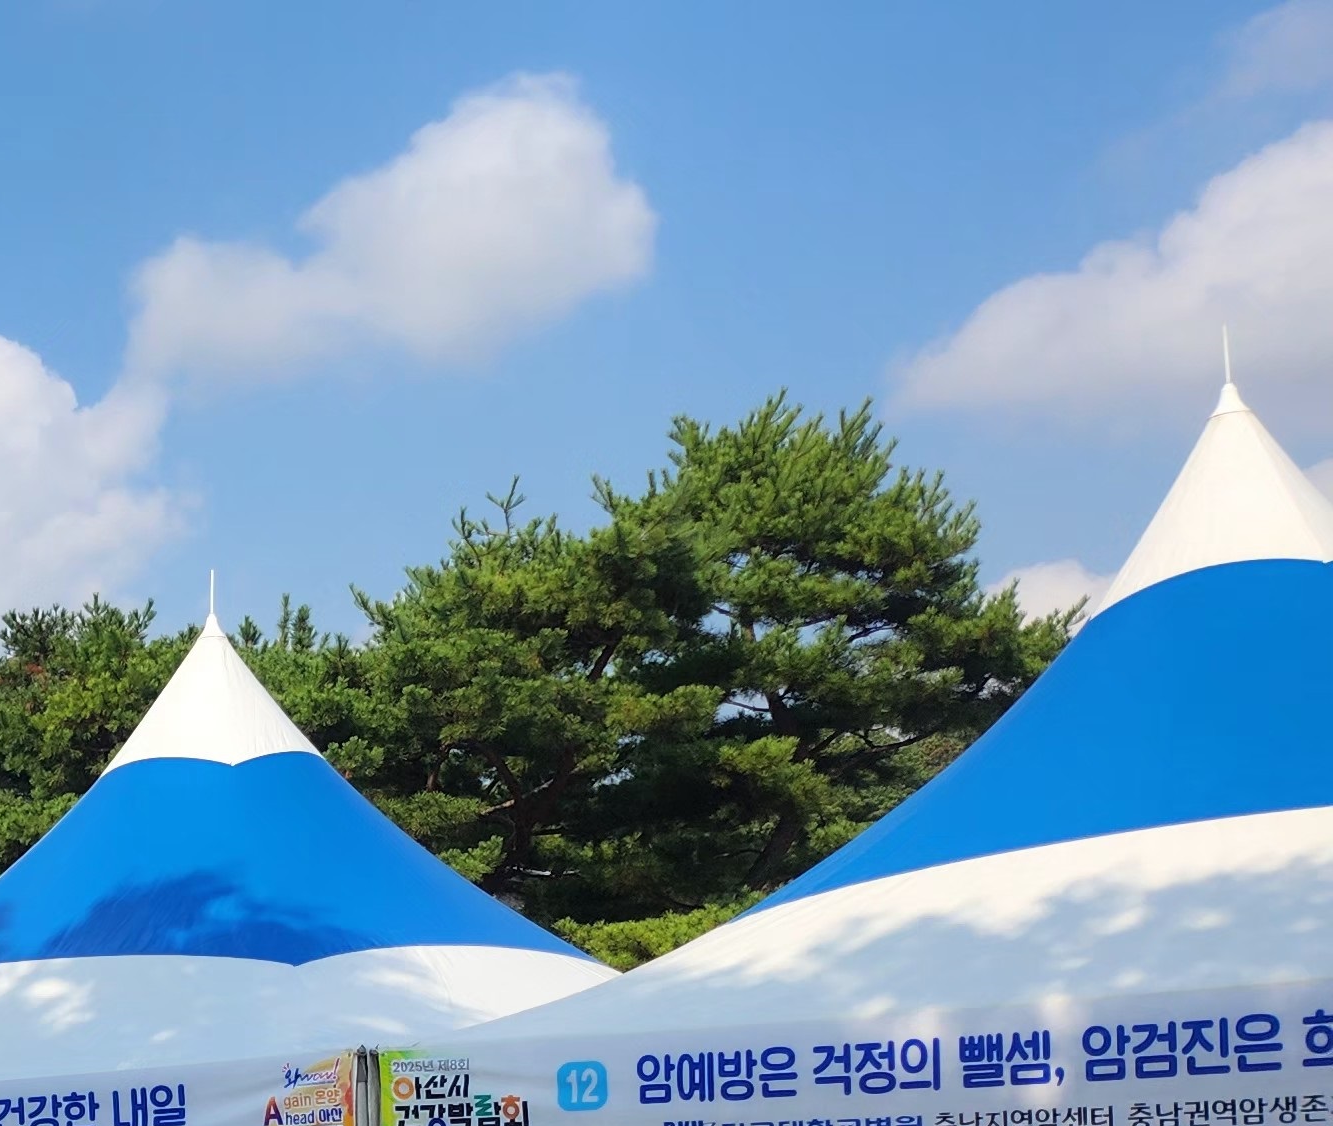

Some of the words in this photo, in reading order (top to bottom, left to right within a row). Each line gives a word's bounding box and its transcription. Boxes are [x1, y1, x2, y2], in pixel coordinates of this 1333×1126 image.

[392, 1060, 434, 1073] 2025년
[437, 1058, 470, 1072] 제8회
[636, 1045, 798, 1104] 암예방은
[812, 1037, 941, 1096] 걱정의
[959, 1030, 1065, 1088] 뺄셈,
[1082, 1013, 1283, 1083] 암검진은
[392, 1074, 470, 1100] 아산시
[566, 1068, 599, 1104] 12
